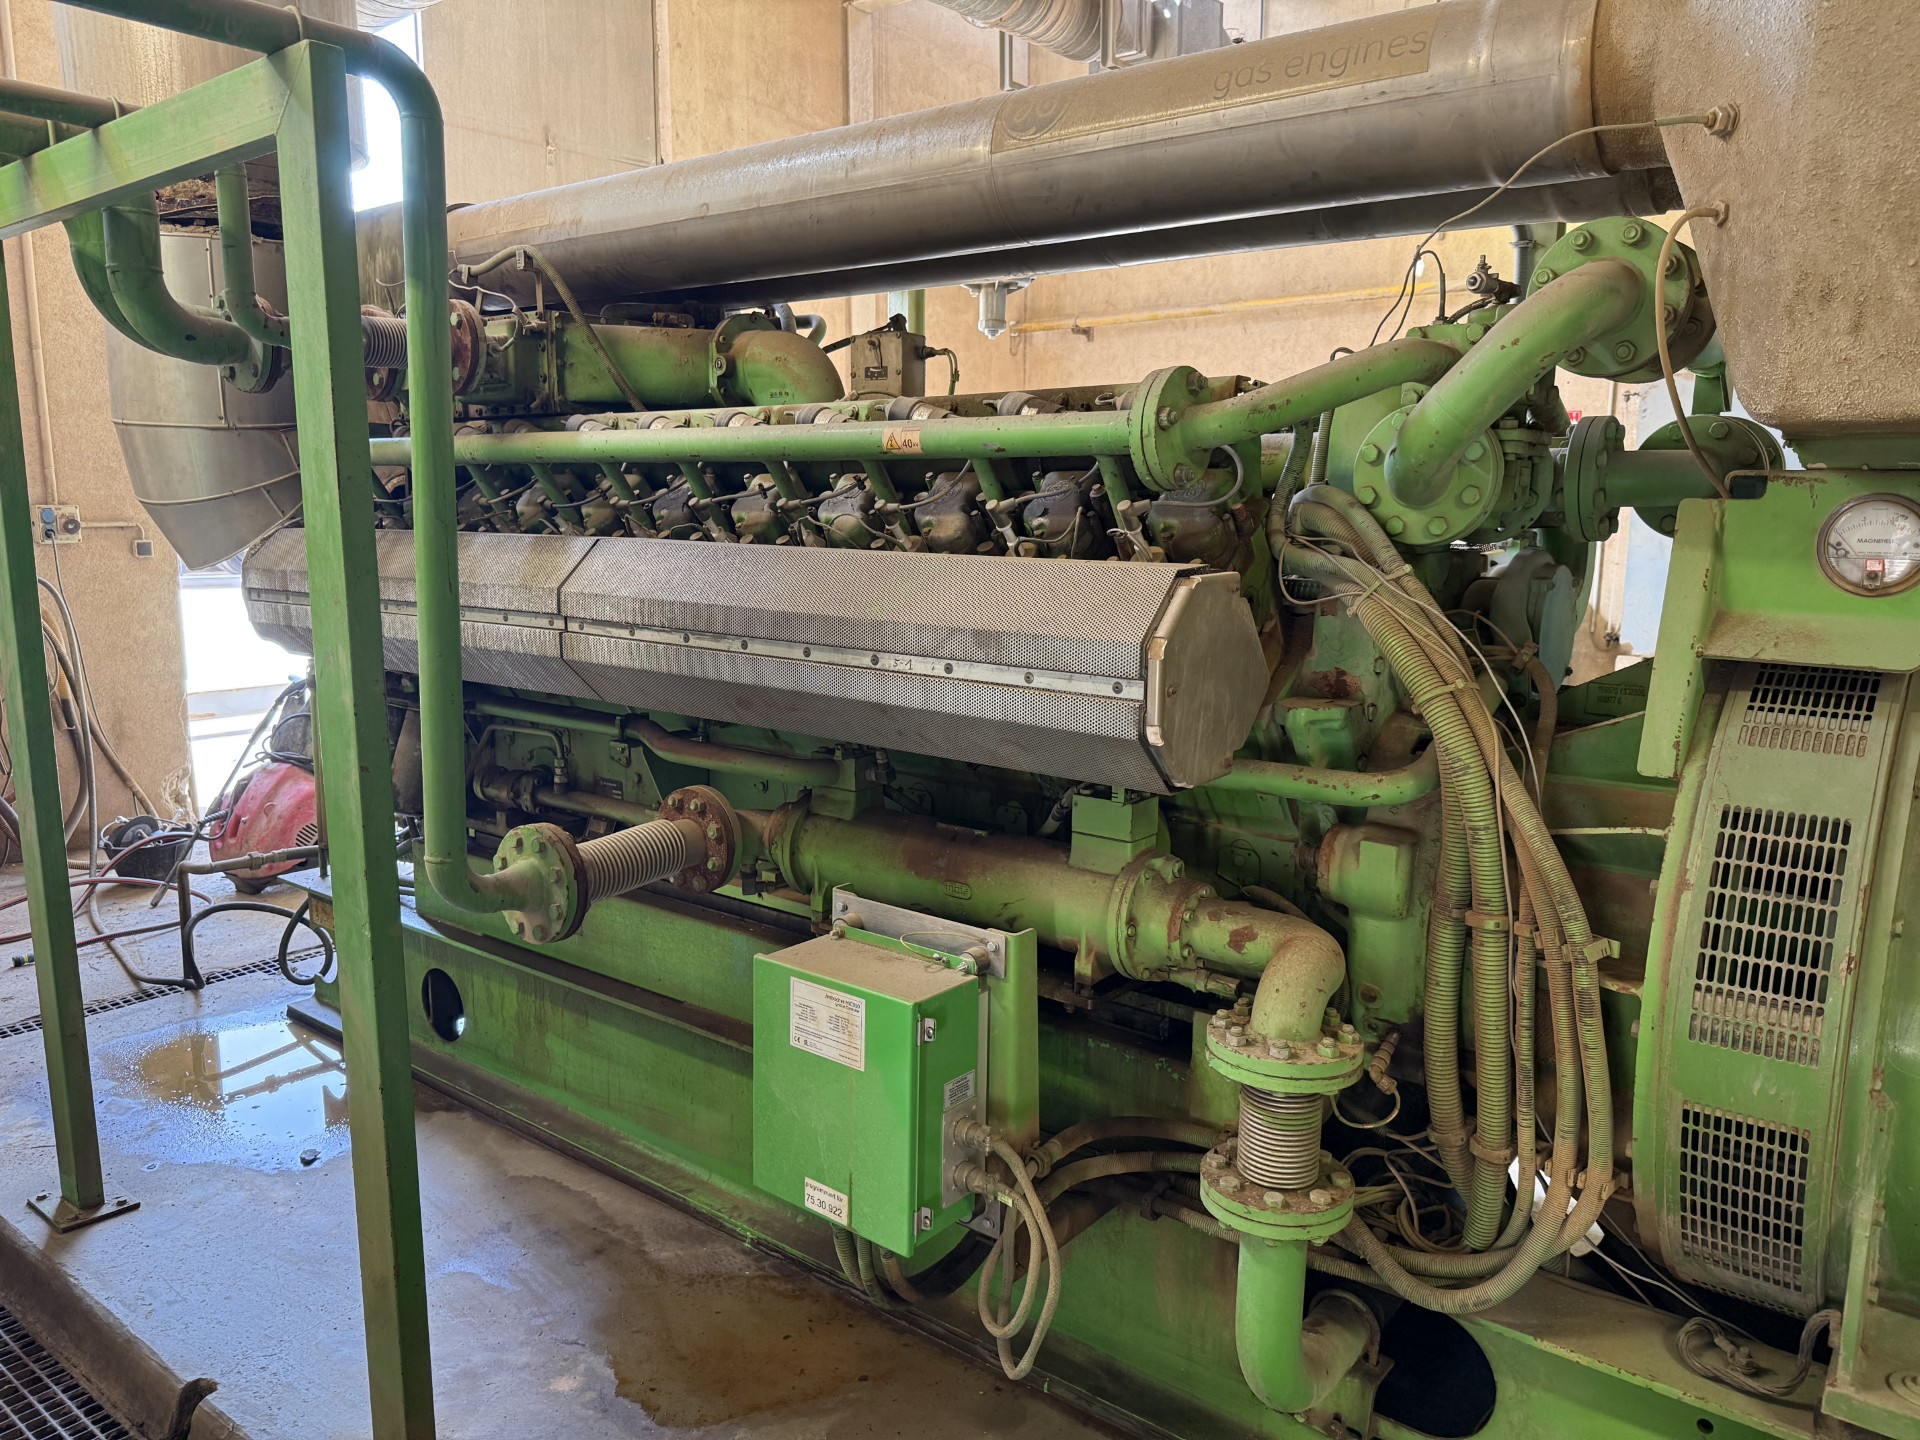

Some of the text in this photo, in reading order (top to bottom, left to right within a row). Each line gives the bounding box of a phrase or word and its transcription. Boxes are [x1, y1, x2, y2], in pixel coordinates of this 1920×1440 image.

[1213, 31, 1428, 100] gas engines
[806, 1192, 843, 1218] 75.30.922
